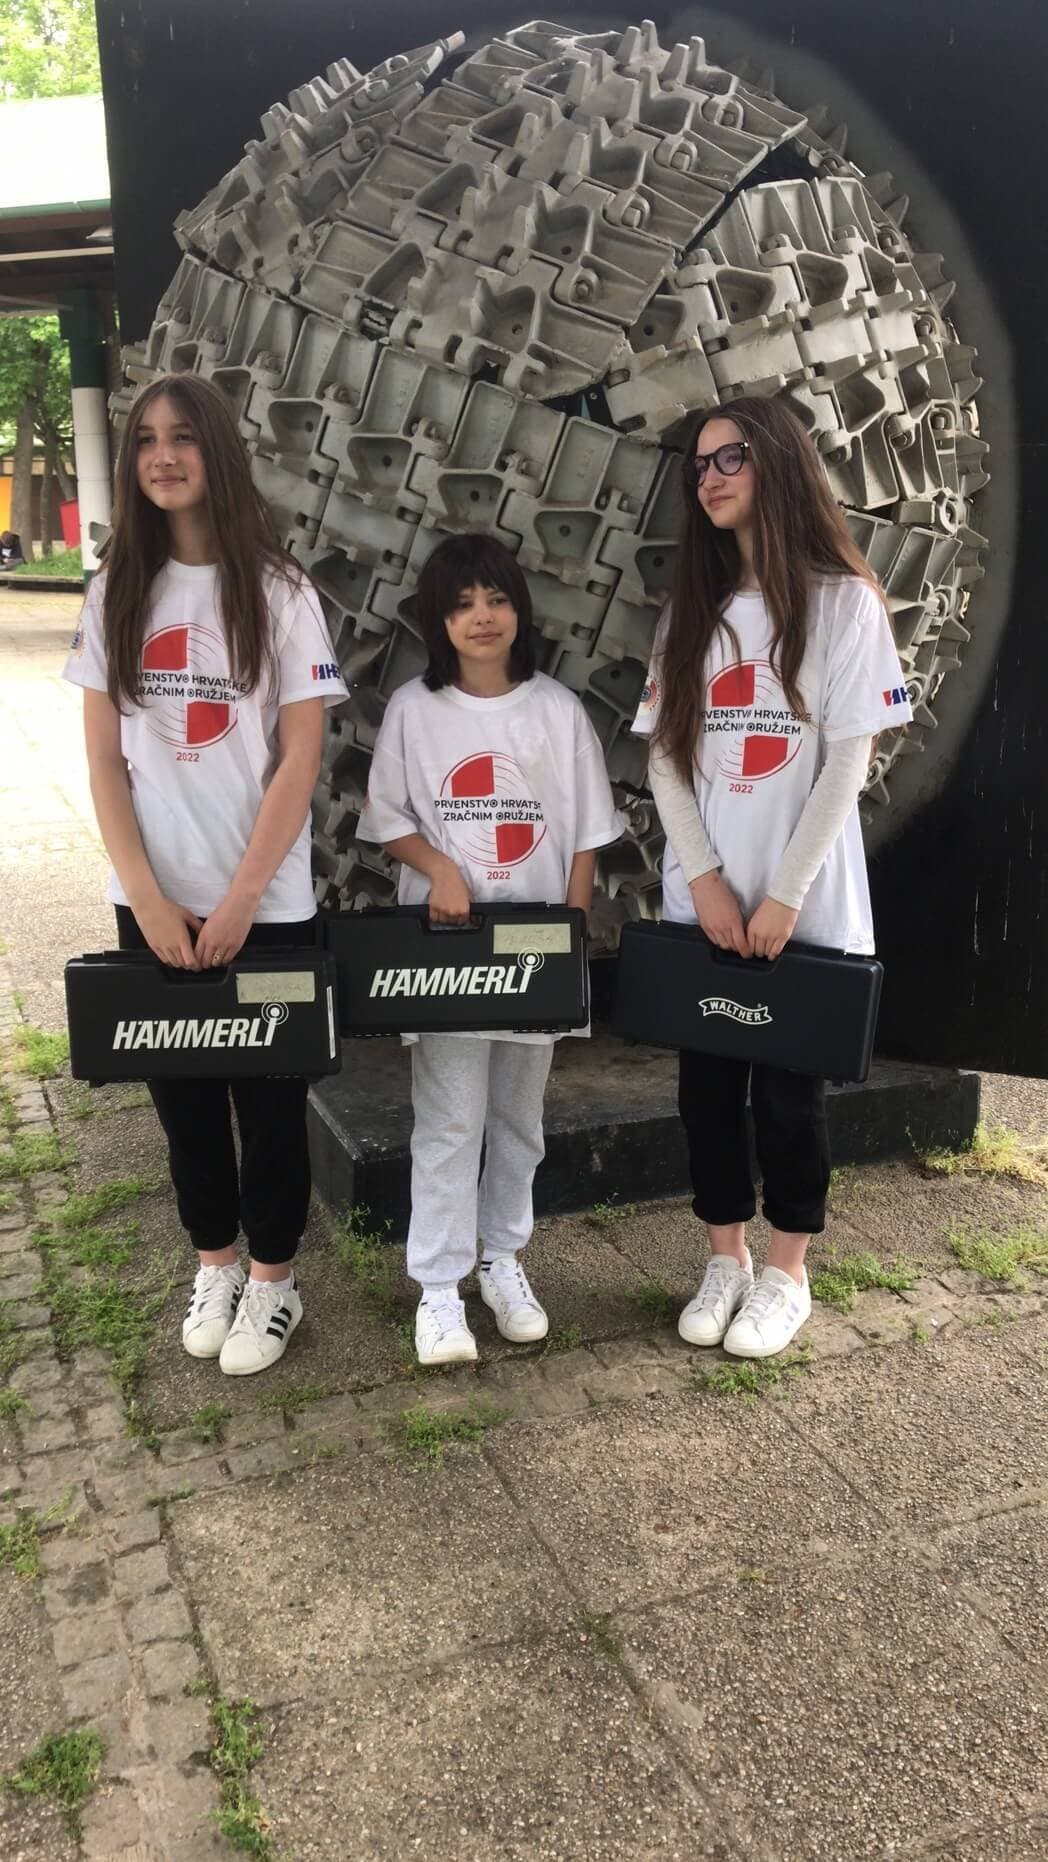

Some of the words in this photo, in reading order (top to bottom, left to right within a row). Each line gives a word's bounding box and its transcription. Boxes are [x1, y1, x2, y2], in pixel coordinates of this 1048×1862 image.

[137, 672, 189, 683] VENSTVO
[138, 683, 184, 697] RAČNIM
[746, 721, 801, 735] ORUŽJEM
[176, 751, 200, 763] 2022
[728, 782, 754, 794] 2022
[434, 799, 498, 809] PRVENSTVO
[443, 809, 492, 822] ZRAČNIM
[495, 809, 544, 822] ORUŽJEM
[486, 870, 511, 881] 2022
[709, 1000, 761, 1022] WALTHER
